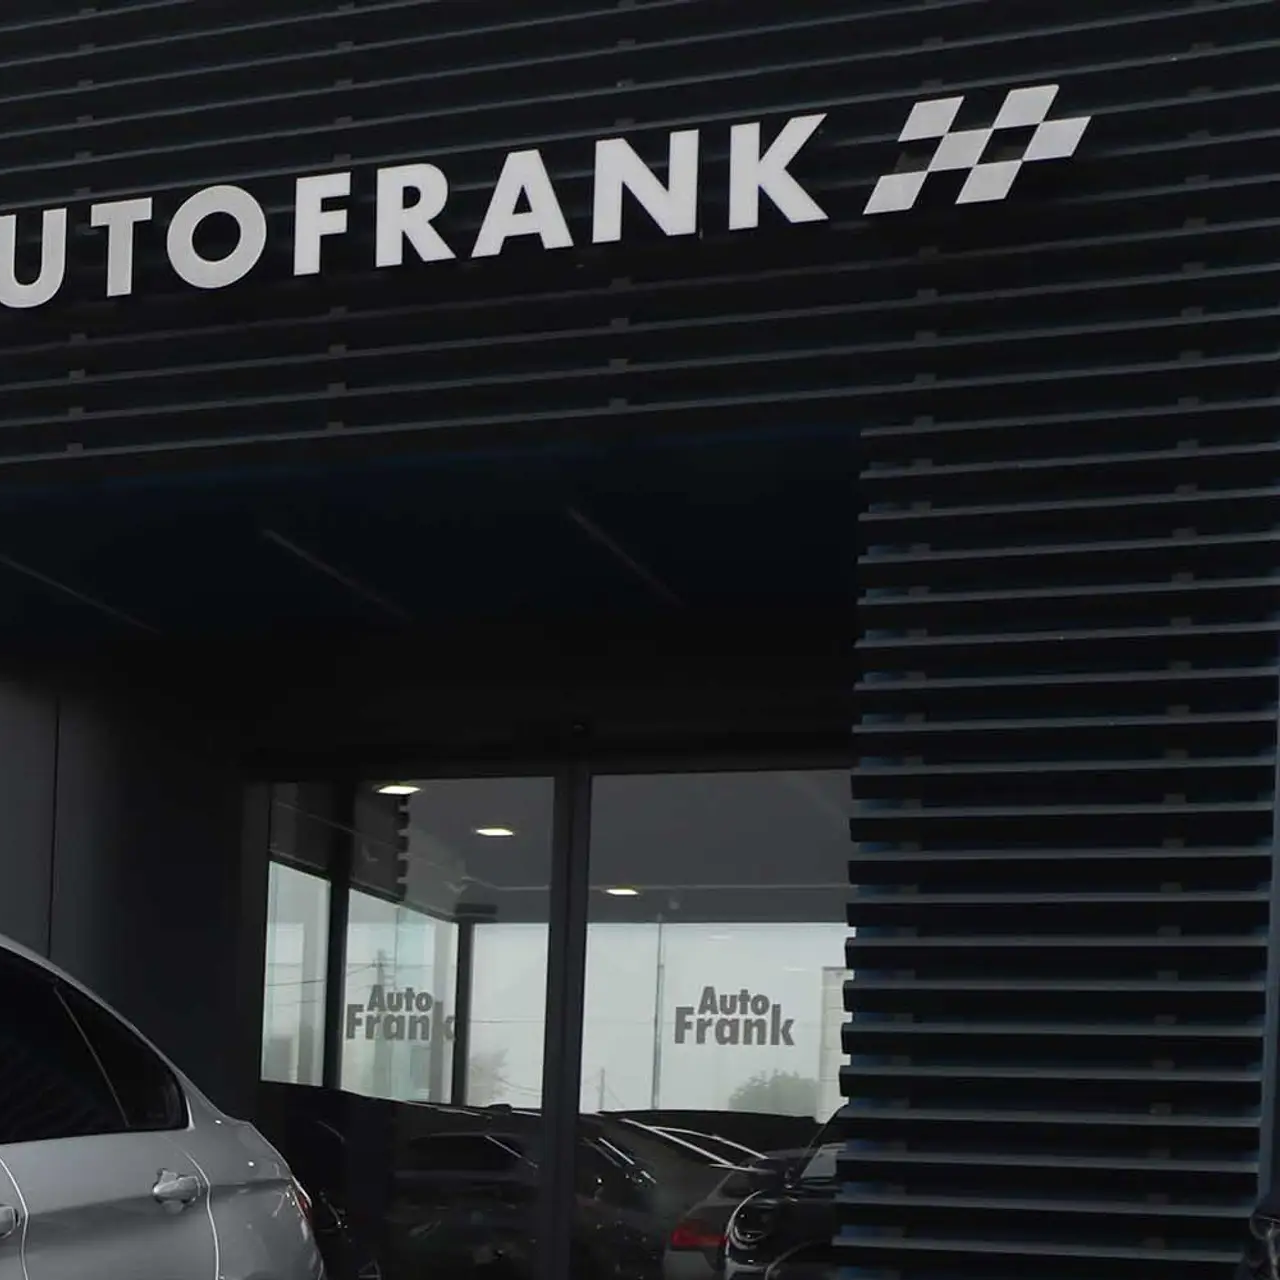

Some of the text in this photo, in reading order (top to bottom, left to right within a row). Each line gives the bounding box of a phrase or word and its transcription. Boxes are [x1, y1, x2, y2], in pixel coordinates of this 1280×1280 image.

[367, 984, 434, 1012] Auto
[697, 985, 770, 1015] Auto
[673, 1003, 795, 1046] Frank
